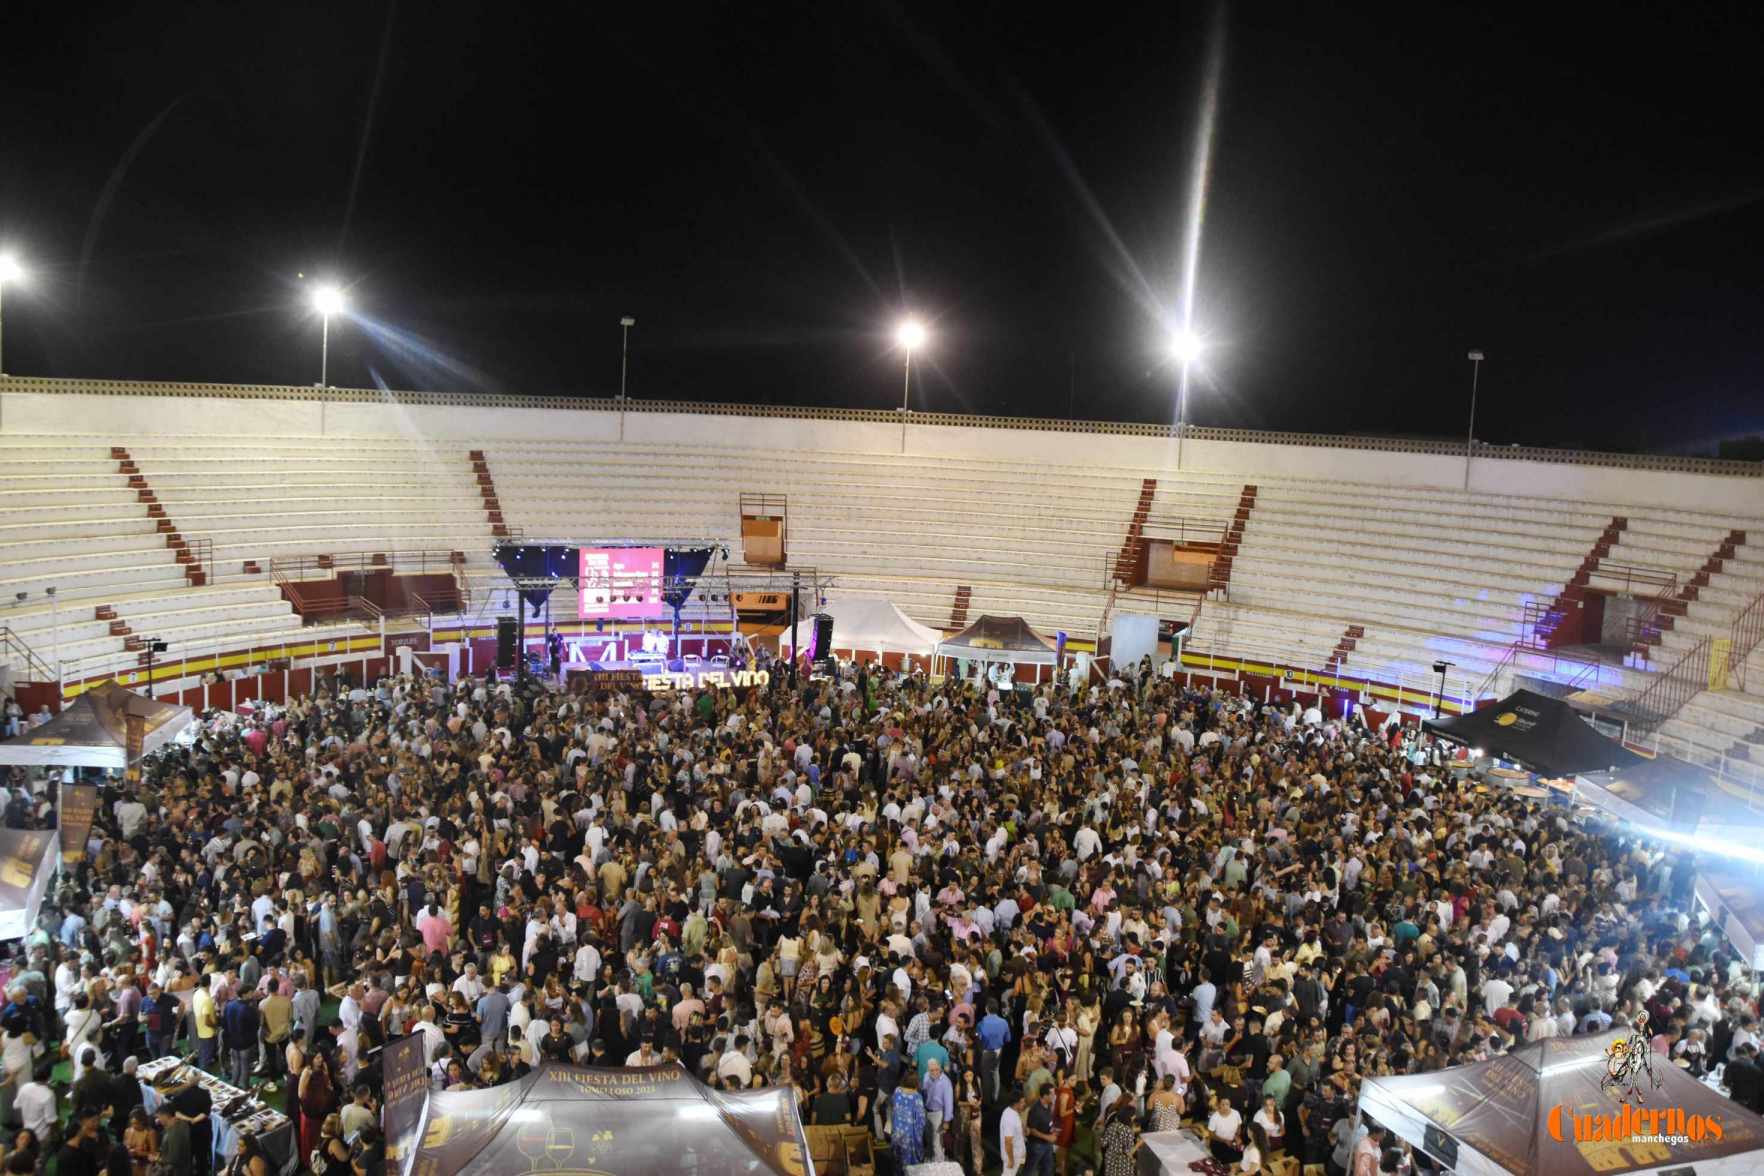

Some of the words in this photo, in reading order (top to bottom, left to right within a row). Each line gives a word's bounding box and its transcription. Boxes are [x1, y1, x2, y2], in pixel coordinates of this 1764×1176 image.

[575, 1073, 618, 1085] FIESTA
[622, 1074, 647, 1085] DEL
[648, 1070, 681, 1082] VINO
